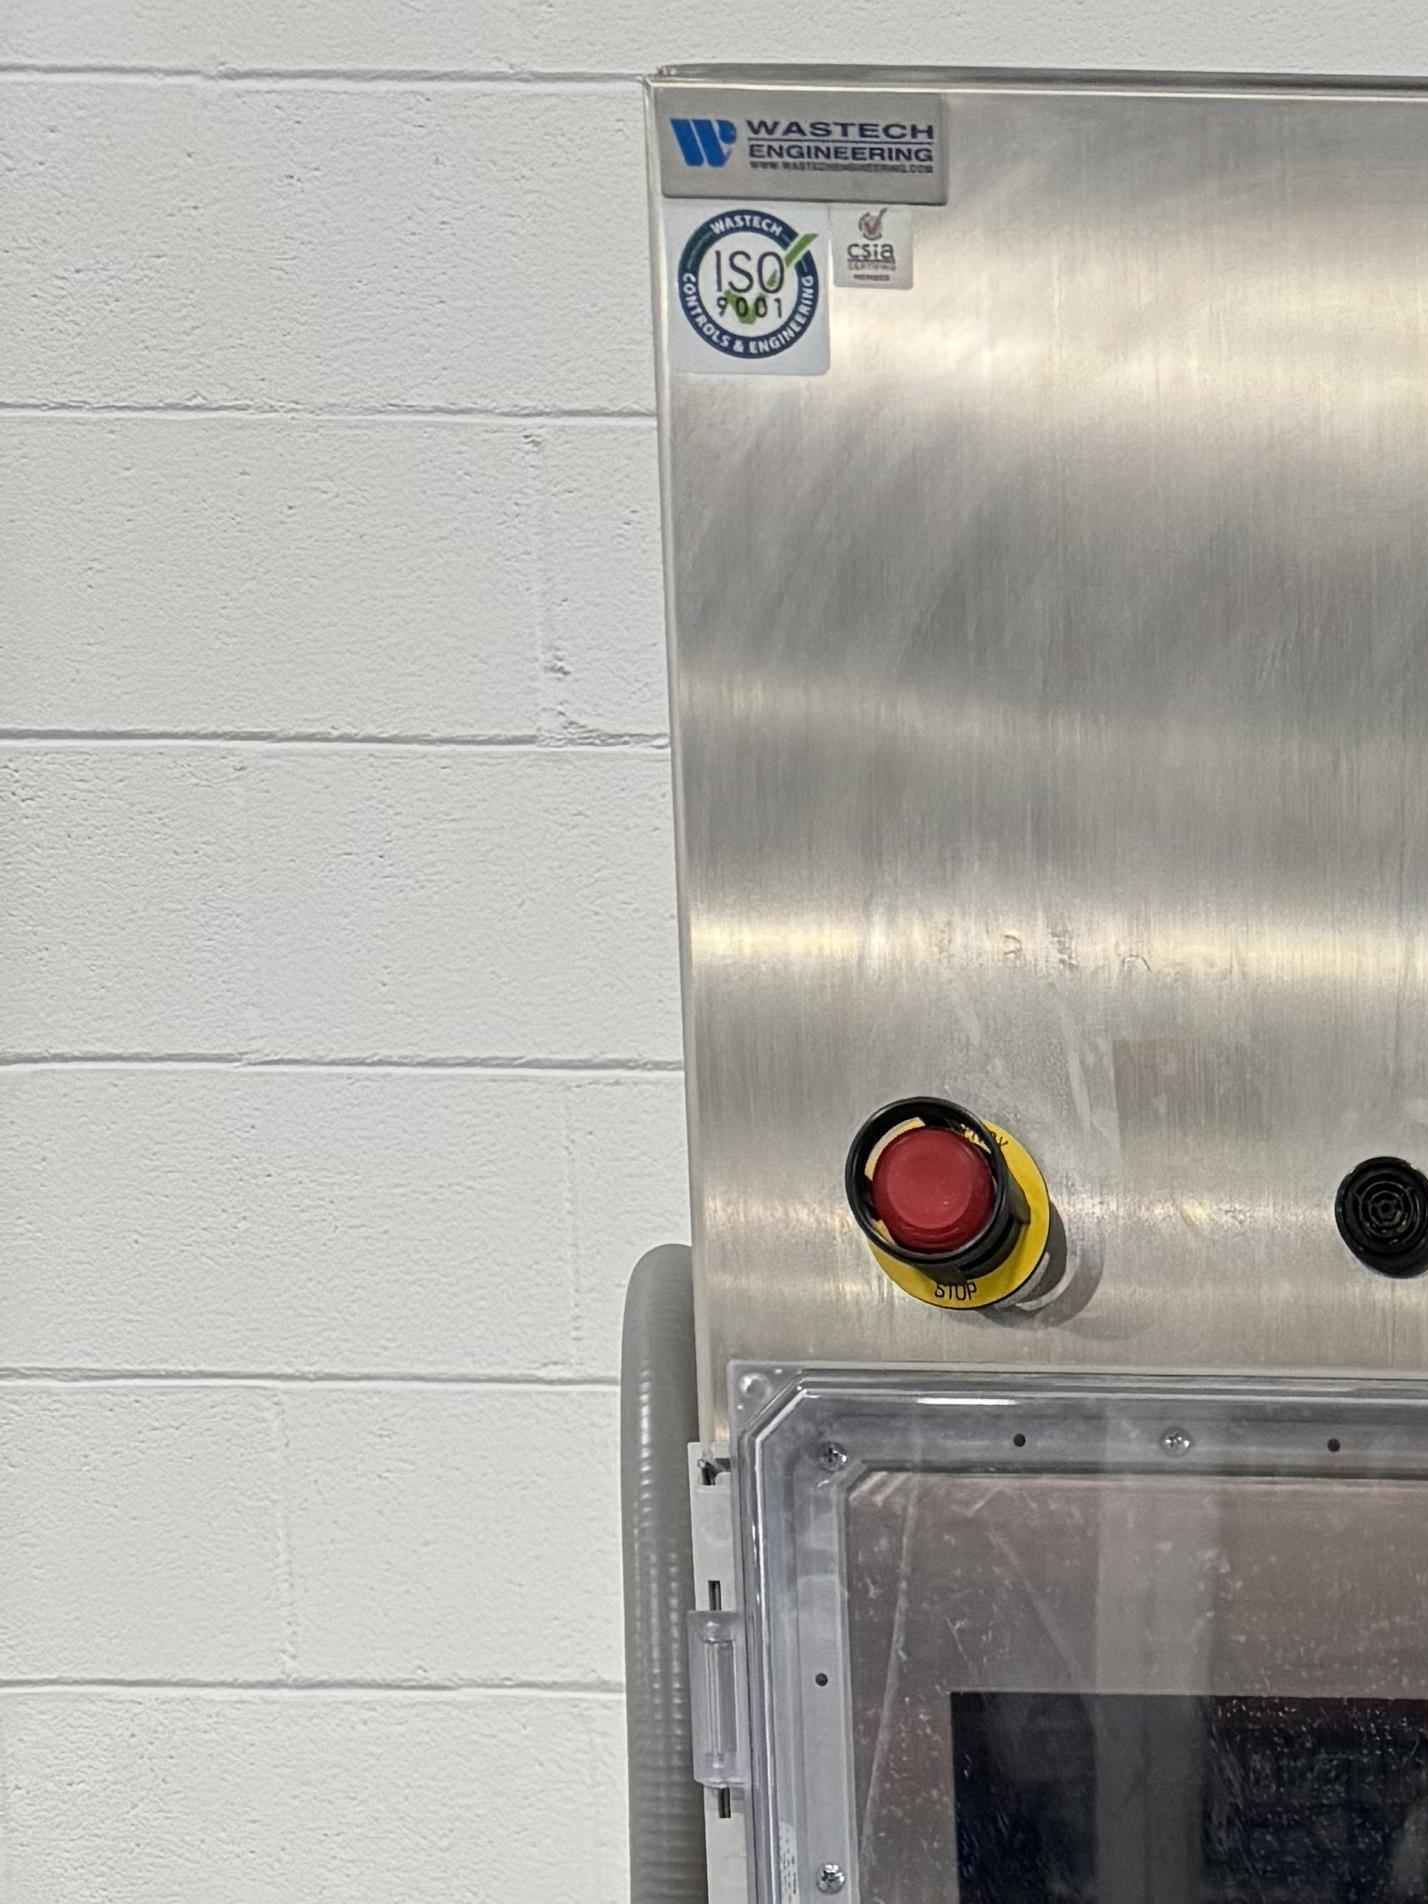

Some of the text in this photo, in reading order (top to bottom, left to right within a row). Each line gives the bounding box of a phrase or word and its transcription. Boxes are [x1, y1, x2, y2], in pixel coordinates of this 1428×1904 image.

[747, 120, 934, 139] WASTECH
[750, 144, 933, 162] ENGINEERING
[710, 215, 782, 237] WASTECH
[714, 250, 784, 293] ISO
[683, 273, 730, 348] CONTROLS
[749, 275, 814, 354] ENGINEERING
[717, 297, 783, 318] 9001
